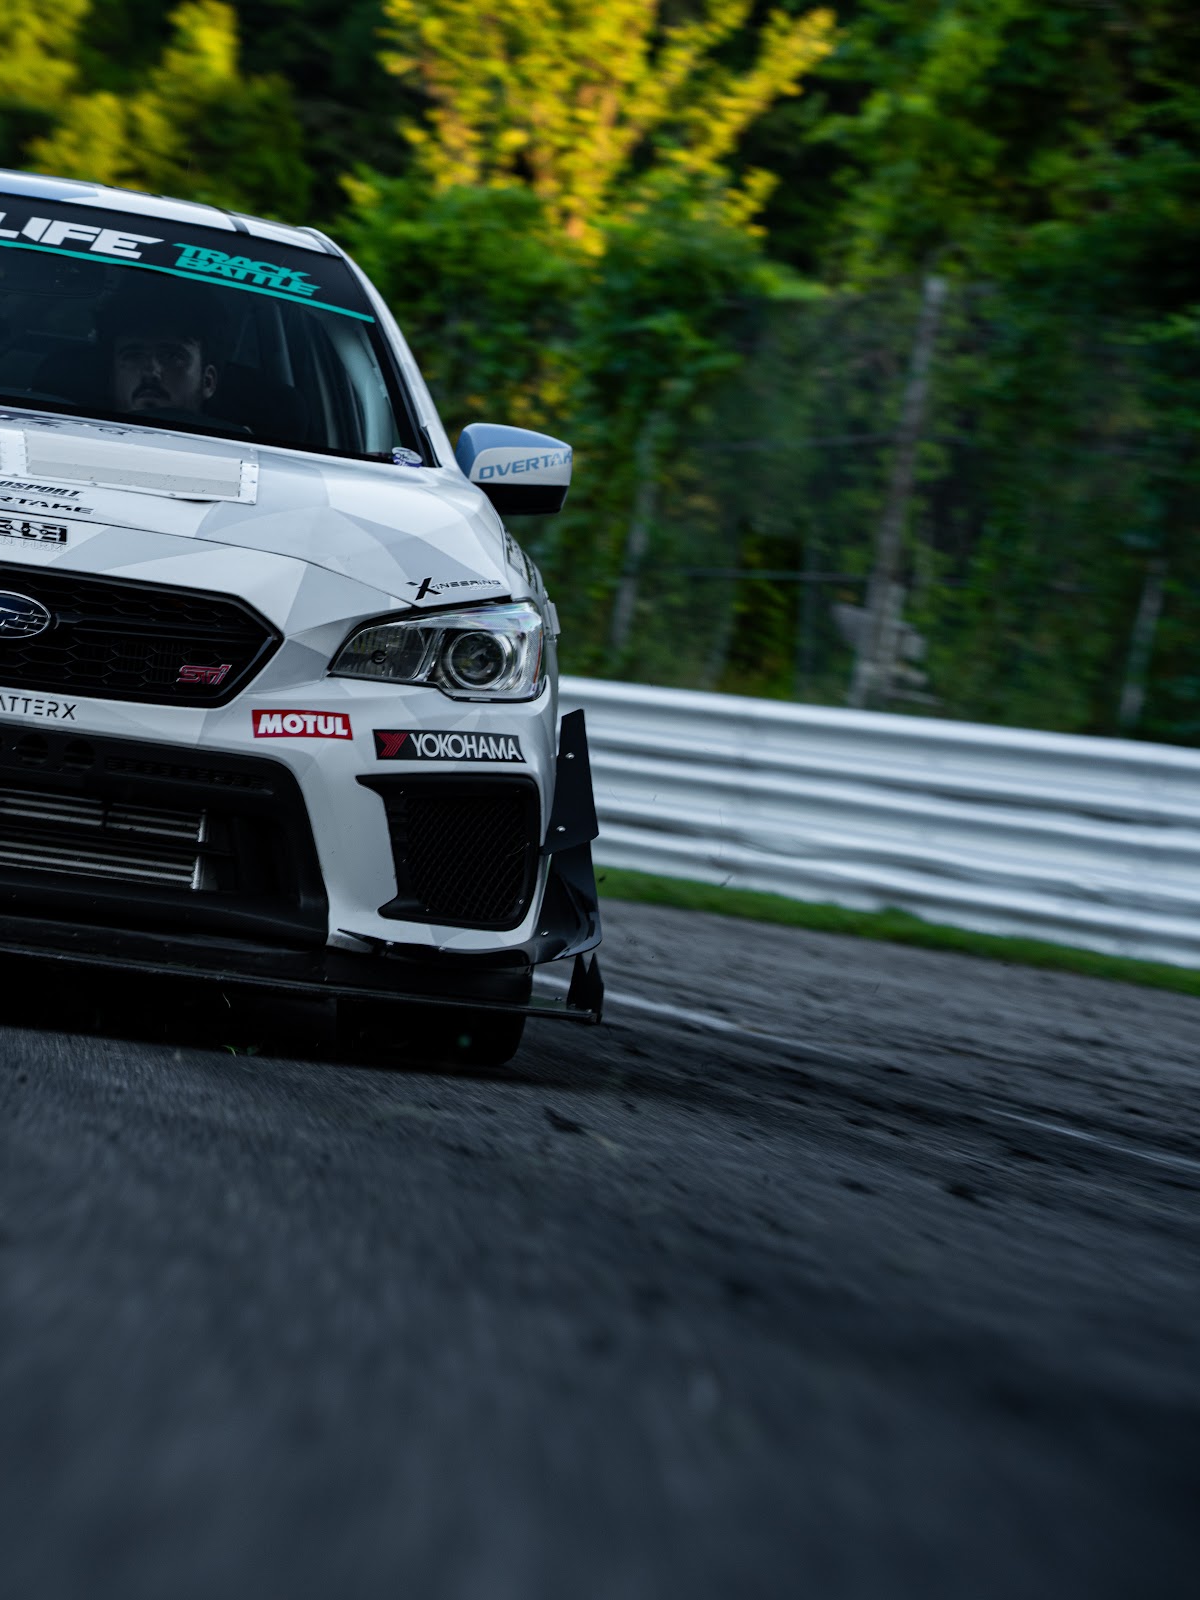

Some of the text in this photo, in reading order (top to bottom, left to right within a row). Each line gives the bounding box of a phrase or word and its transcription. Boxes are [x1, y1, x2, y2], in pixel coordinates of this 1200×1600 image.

[172, 243, 311, 282] TRACK
[175, 256, 321, 297] BATTLE
[258, 713, 348, 736] MOTUL
[409, 733, 523, 761] YOKOHAMA
